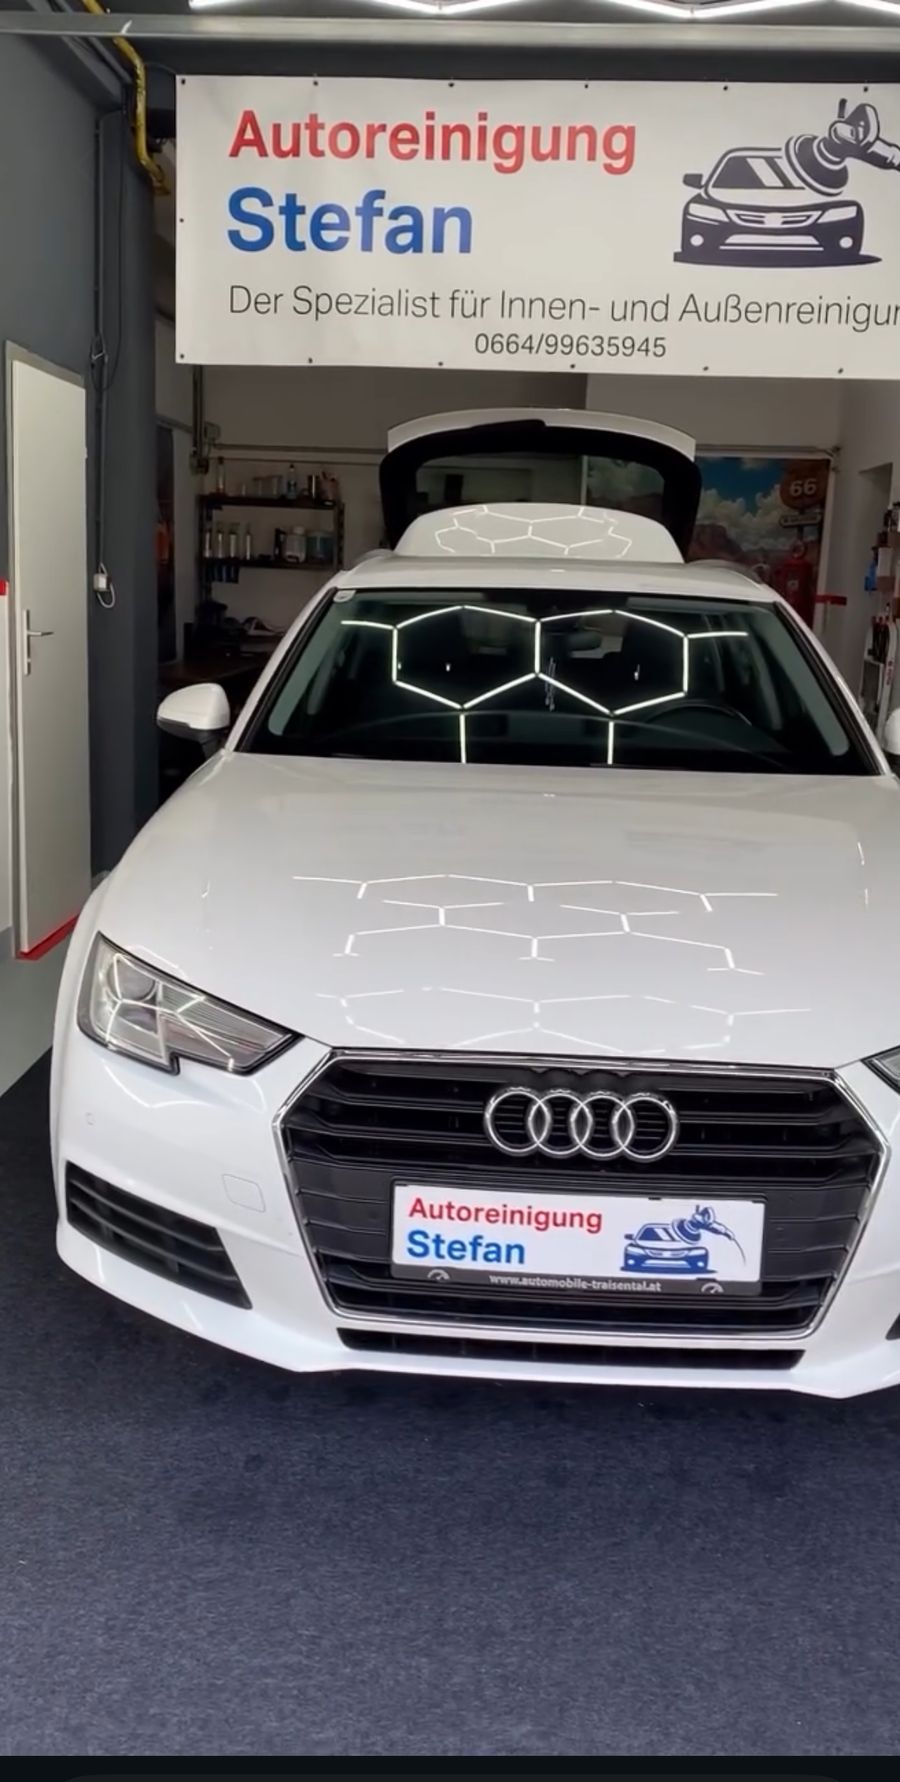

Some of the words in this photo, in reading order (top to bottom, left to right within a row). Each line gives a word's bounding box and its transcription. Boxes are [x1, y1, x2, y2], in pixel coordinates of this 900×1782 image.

[229, 110, 636, 175] Autoreinigung
[228, 186, 471, 252] Stefan
[229, 284, 284, 315] Der
[292, 284, 441, 322] Spezialist
[448, 288, 495, 319] für
[500, 289, 601, 321] Innen-
[610, 293, 670, 323] und
[474, 332, 667, 358] 0664/99635945
[789, 478, 817, 497] 66
[408, 1197, 603, 1234] Autoreinigung
[406, 1229, 526, 1264] Stefan
[488, 1274, 662, 1292] www.automobile-traisental.at
